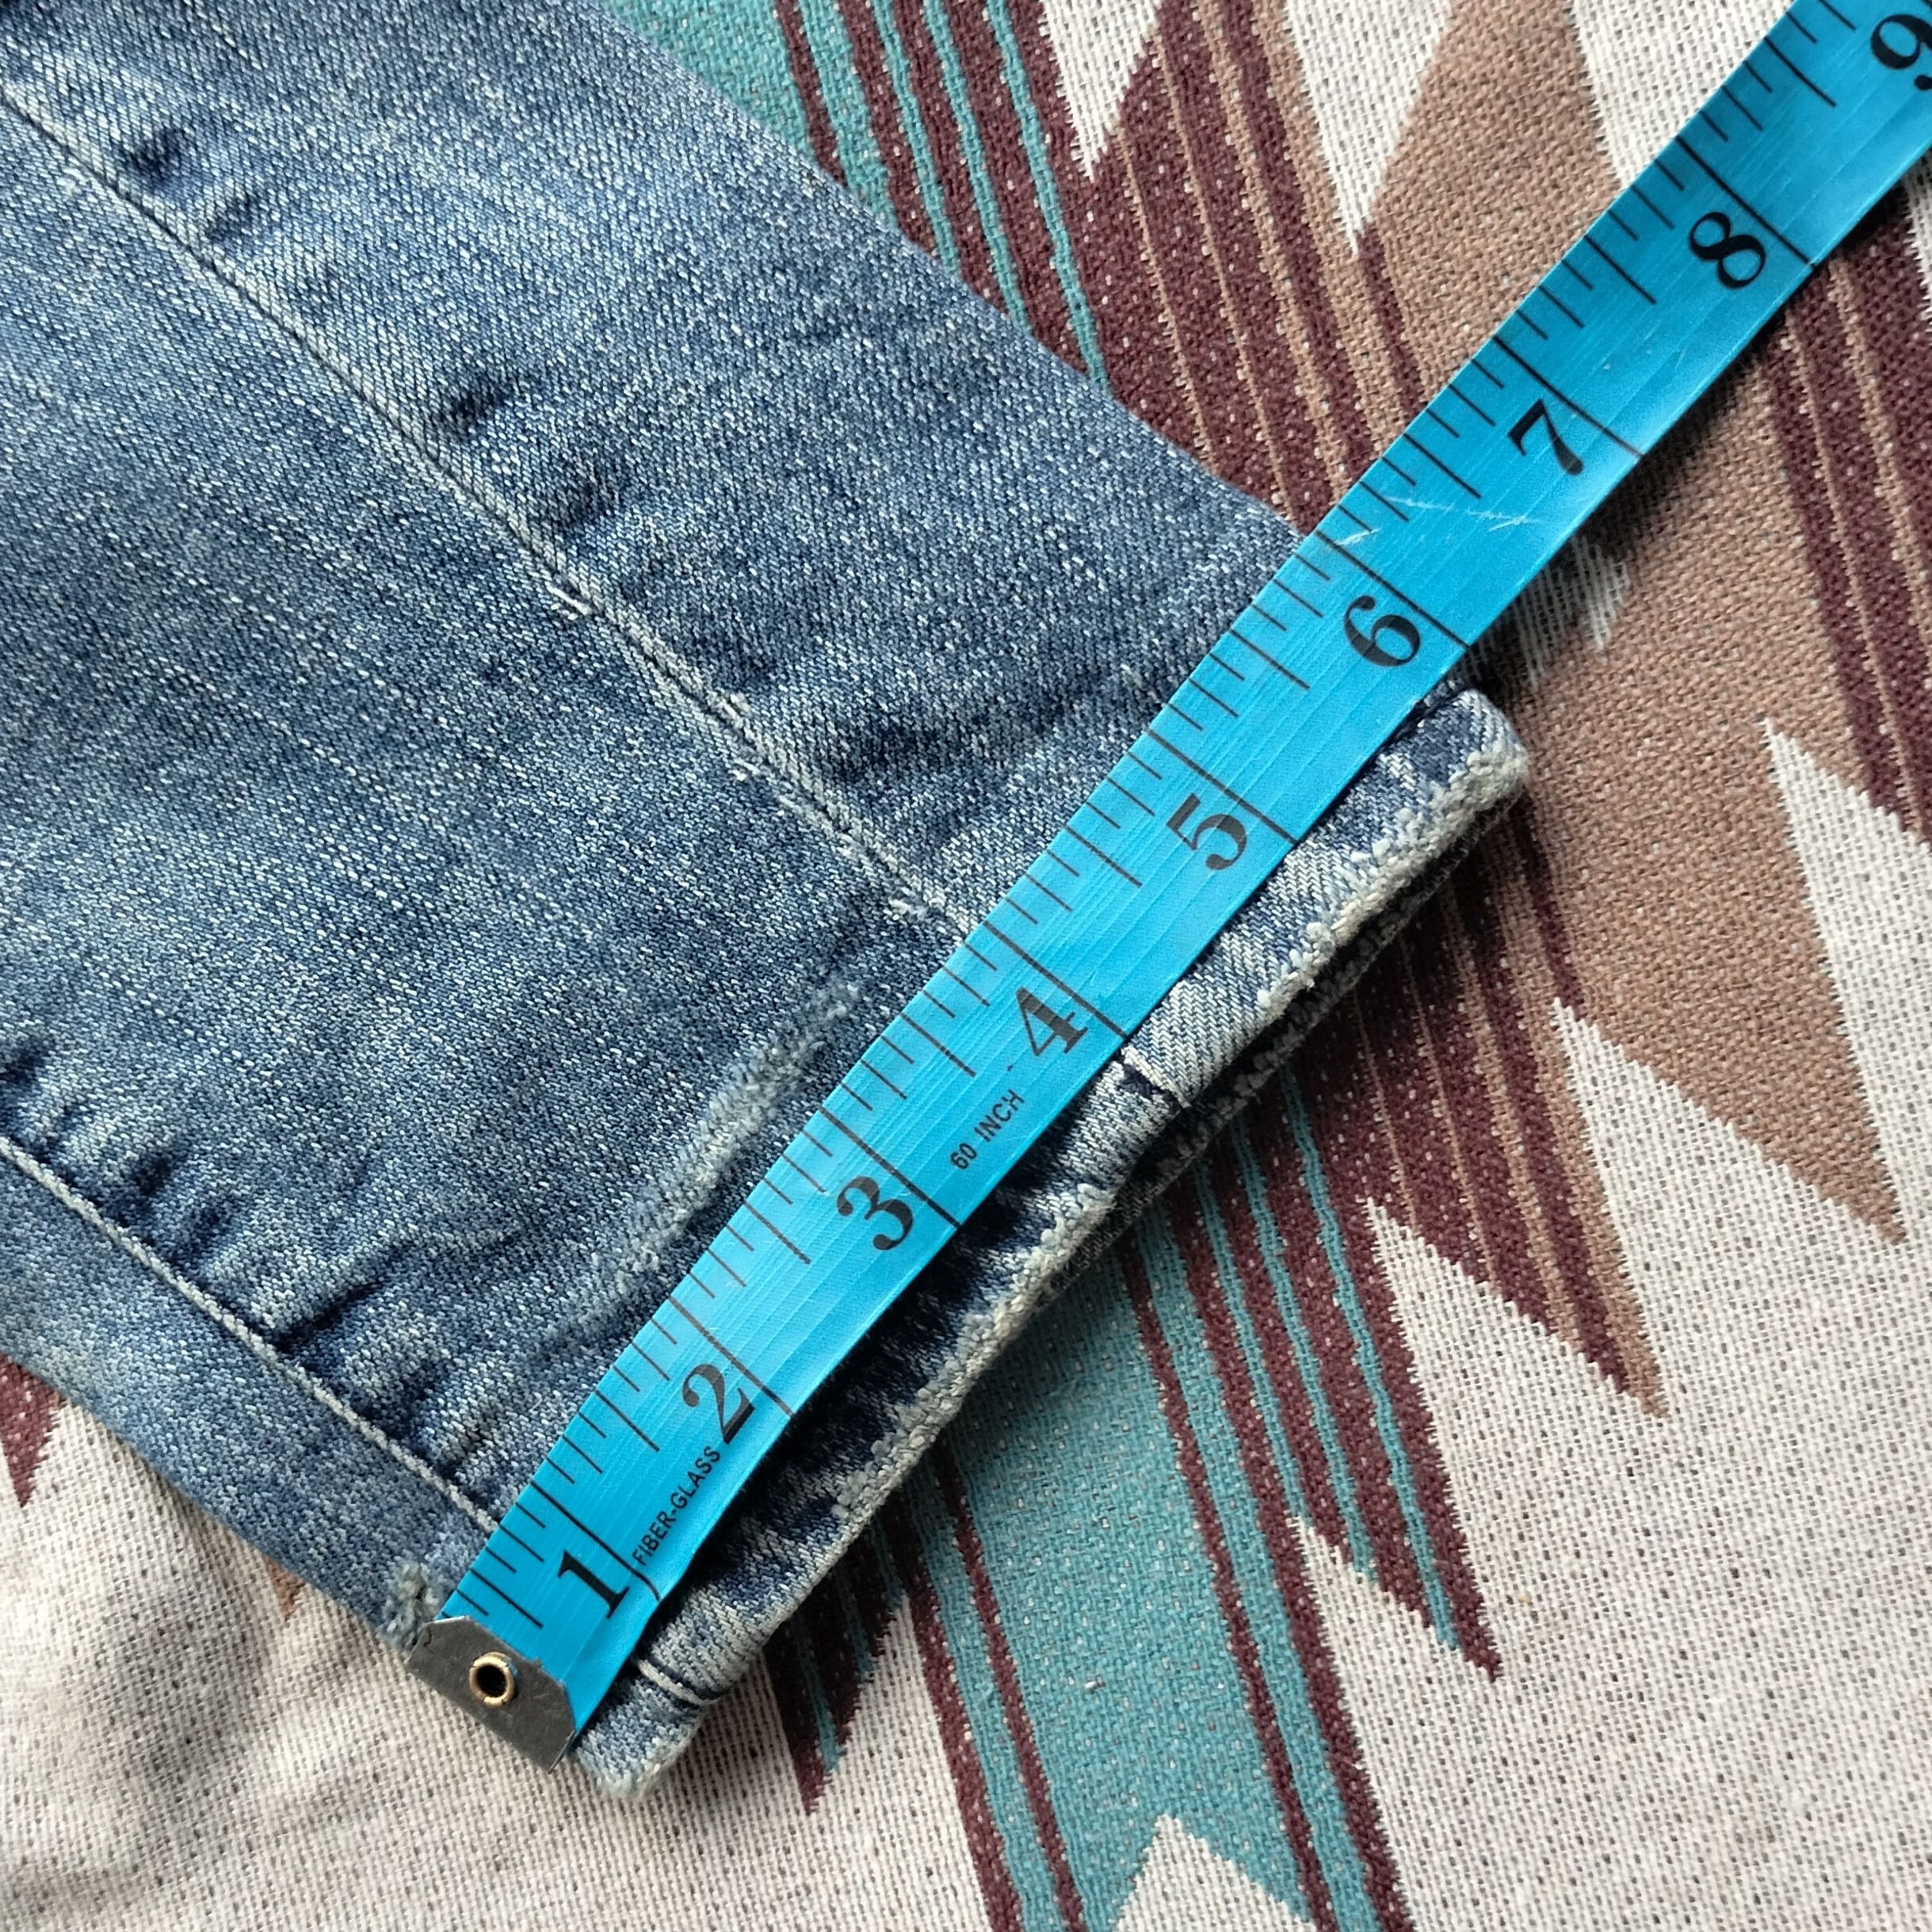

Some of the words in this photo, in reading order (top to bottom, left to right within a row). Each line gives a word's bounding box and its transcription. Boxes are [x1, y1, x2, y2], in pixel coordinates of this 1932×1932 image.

[1870, 13, 1932, 92] 9
[1689, 212, 1766, 289] 8
[1509, 399, 1583, 475] 7
[1344, 595, 1421, 667] 6
[1166, 793, 1247, 870] 5
[1016, 987, 1089, 1056] 4
[950, 1143, 977, 1170] 60
[974, 1089, 1025, 1143] INCH
[837, 1175, 914, 1250] 3
[682, 1364, 756, 1445] 2
[632, 1445, 721, 1566] FIBER-GLASS
[558, 1549, 630, 1619] 1
